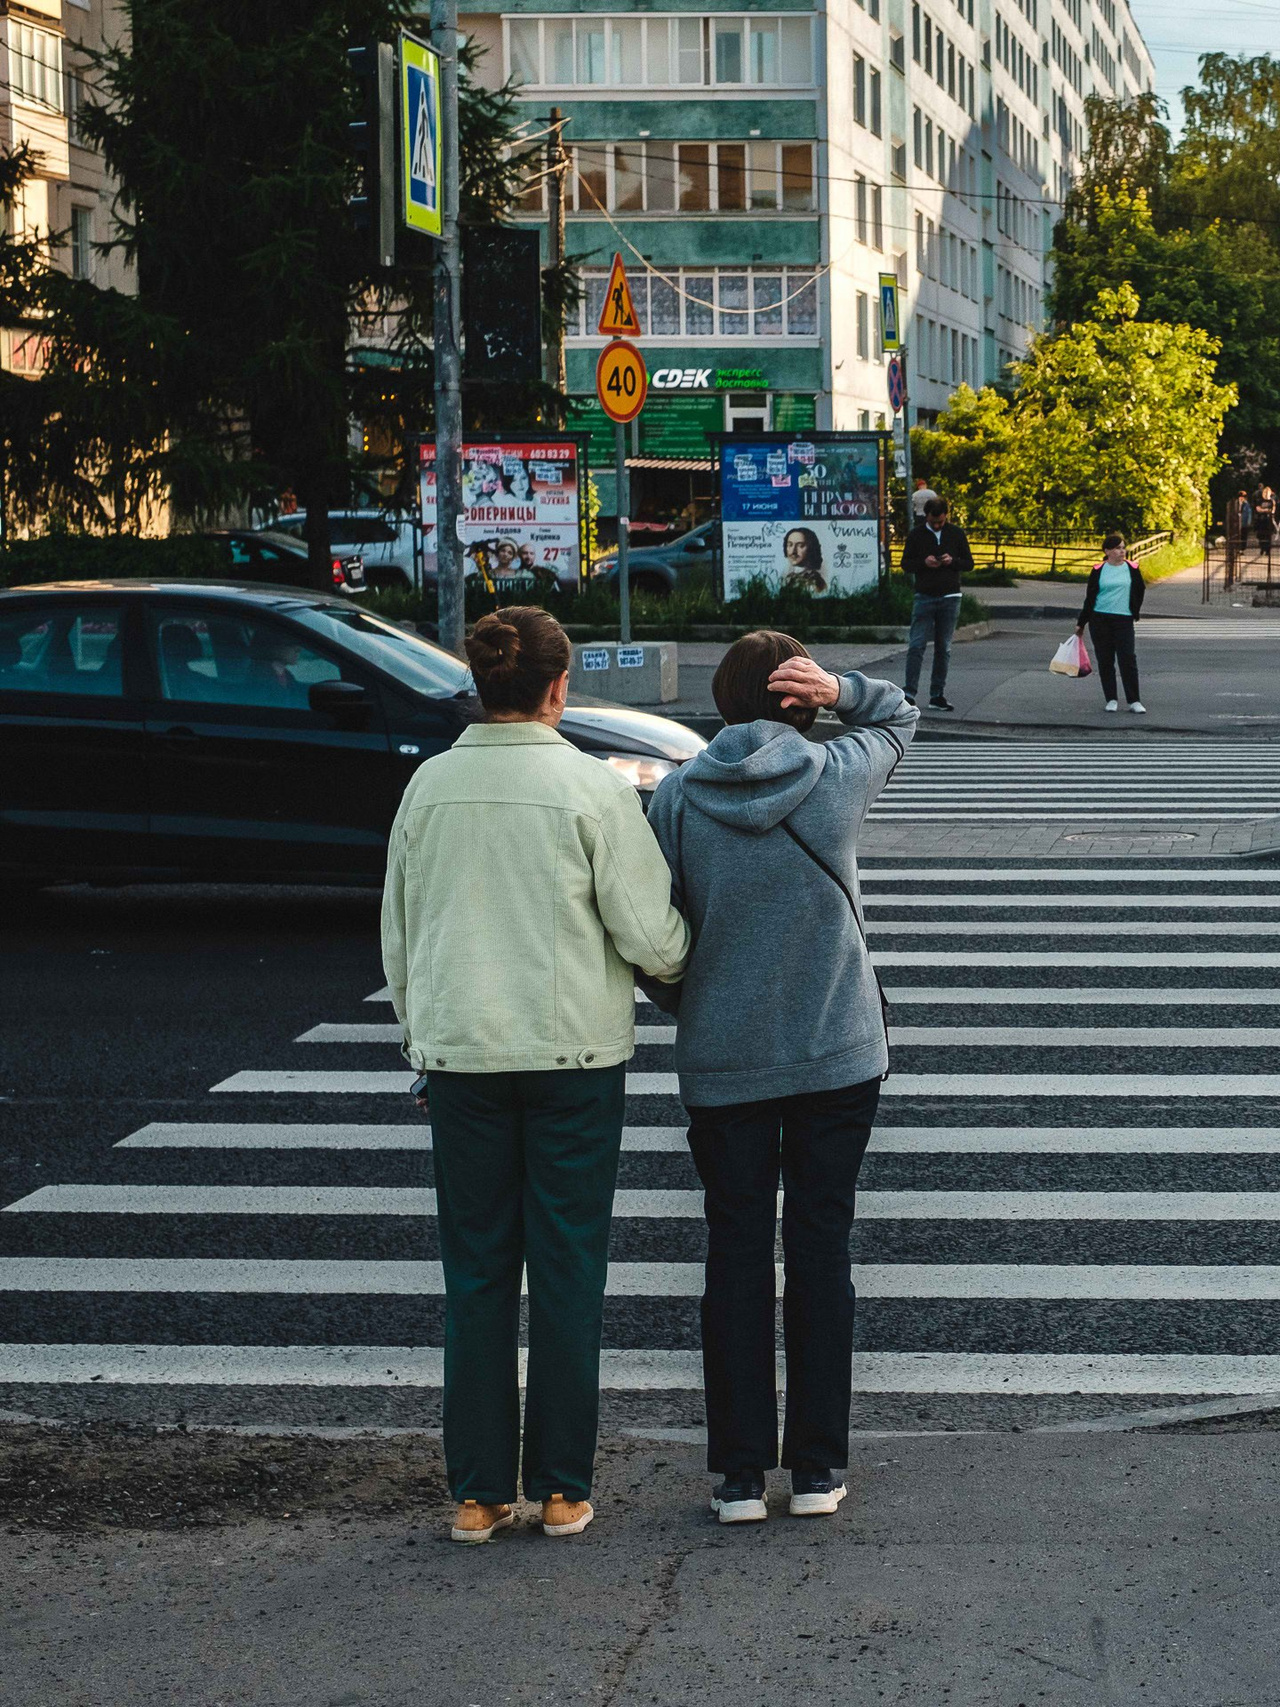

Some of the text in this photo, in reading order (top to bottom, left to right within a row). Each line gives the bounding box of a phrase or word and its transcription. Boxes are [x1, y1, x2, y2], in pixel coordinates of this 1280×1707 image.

[652, 368, 712, 388] CDEK
[716, 368, 763, 378] экспресс
[606, 365, 637, 397] 40
[715, 378, 769, 388] доставка
[543, 547, 560, 561] 27
